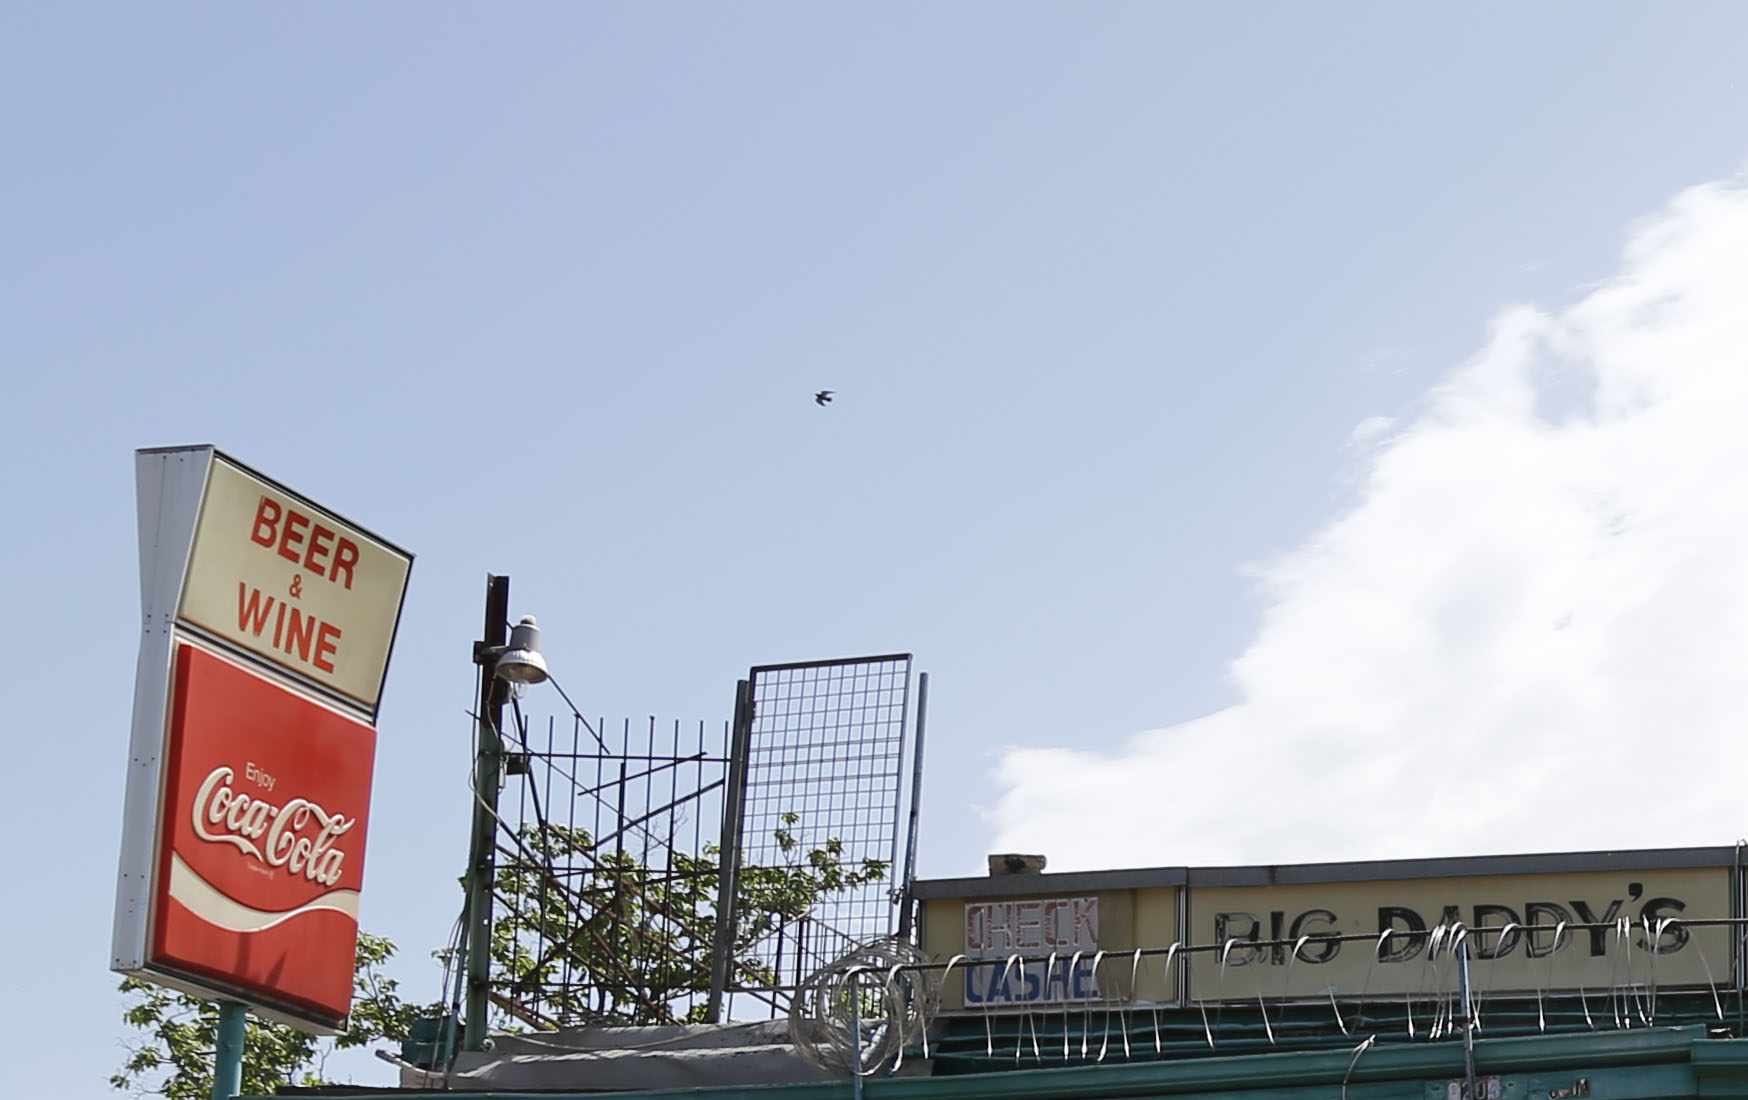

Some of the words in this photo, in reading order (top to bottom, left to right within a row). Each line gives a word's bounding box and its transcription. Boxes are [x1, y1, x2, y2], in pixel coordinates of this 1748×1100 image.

[250, 496, 359, 590] BEER
[289, 574, 302, 598] &
[238, 581, 341, 675] WINE
[245, 762, 276, 792] Enjoy
[192, 766, 356, 886] Coca-Cola
[967, 899, 1099, 950] CHECK
[1215, 909, 1342, 966] BIG
[1378, 883, 1690, 963] DADDY'S
